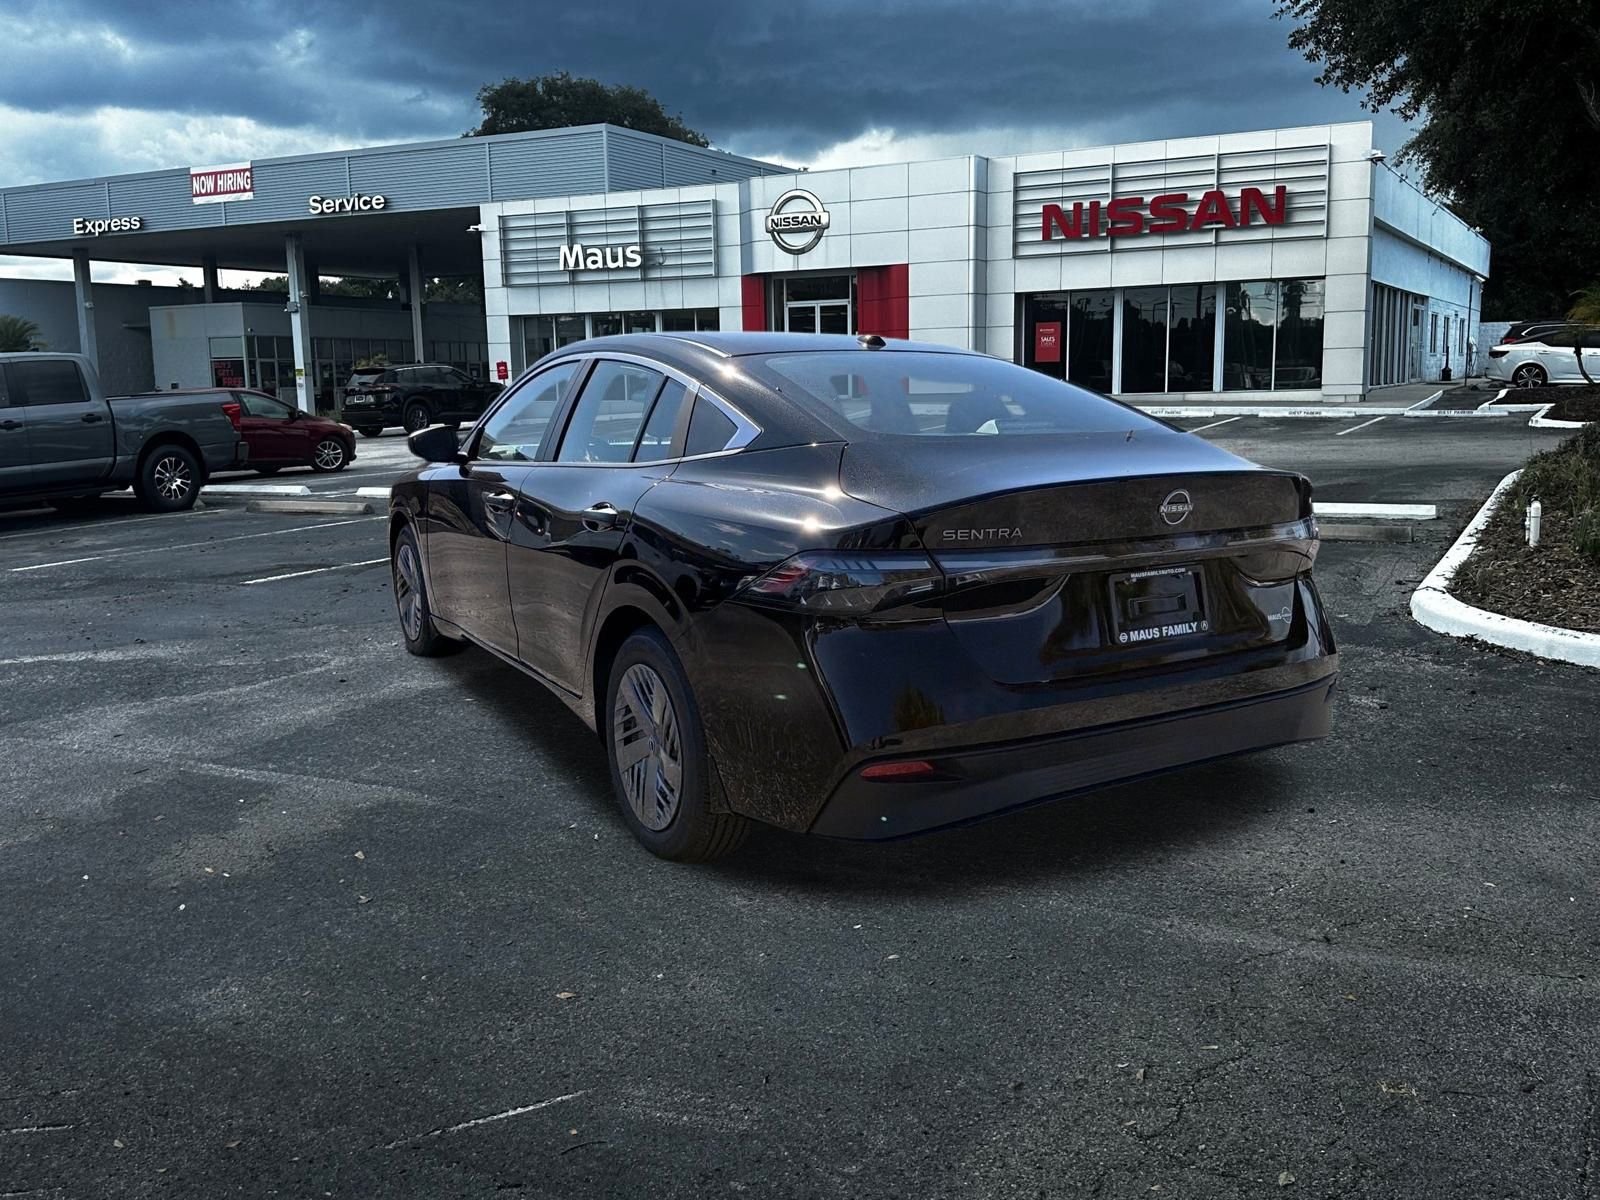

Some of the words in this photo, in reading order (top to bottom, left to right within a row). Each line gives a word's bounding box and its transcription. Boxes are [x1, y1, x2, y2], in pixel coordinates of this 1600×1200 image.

[192, 174, 215, 195] NOW
[217, 171, 251, 192] HIRING
[309, 193, 385, 215] Service
[1041, 185, 1287, 241] NISSAN
[73, 216, 141, 236] Express
[770, 214, 822, 228] NISSAN
[559, 243, 642, 270] Maus
[1160, 503, 1193, 513] NISSAN
[942, 527, 1023, 541] SENTRA
[1130, 567, 1186, 579] MAUSFAMILYAUTO.COM
[1129, 627, 1160, 642] MAUS
[1161, 621, 1198, 637] FAMILY
